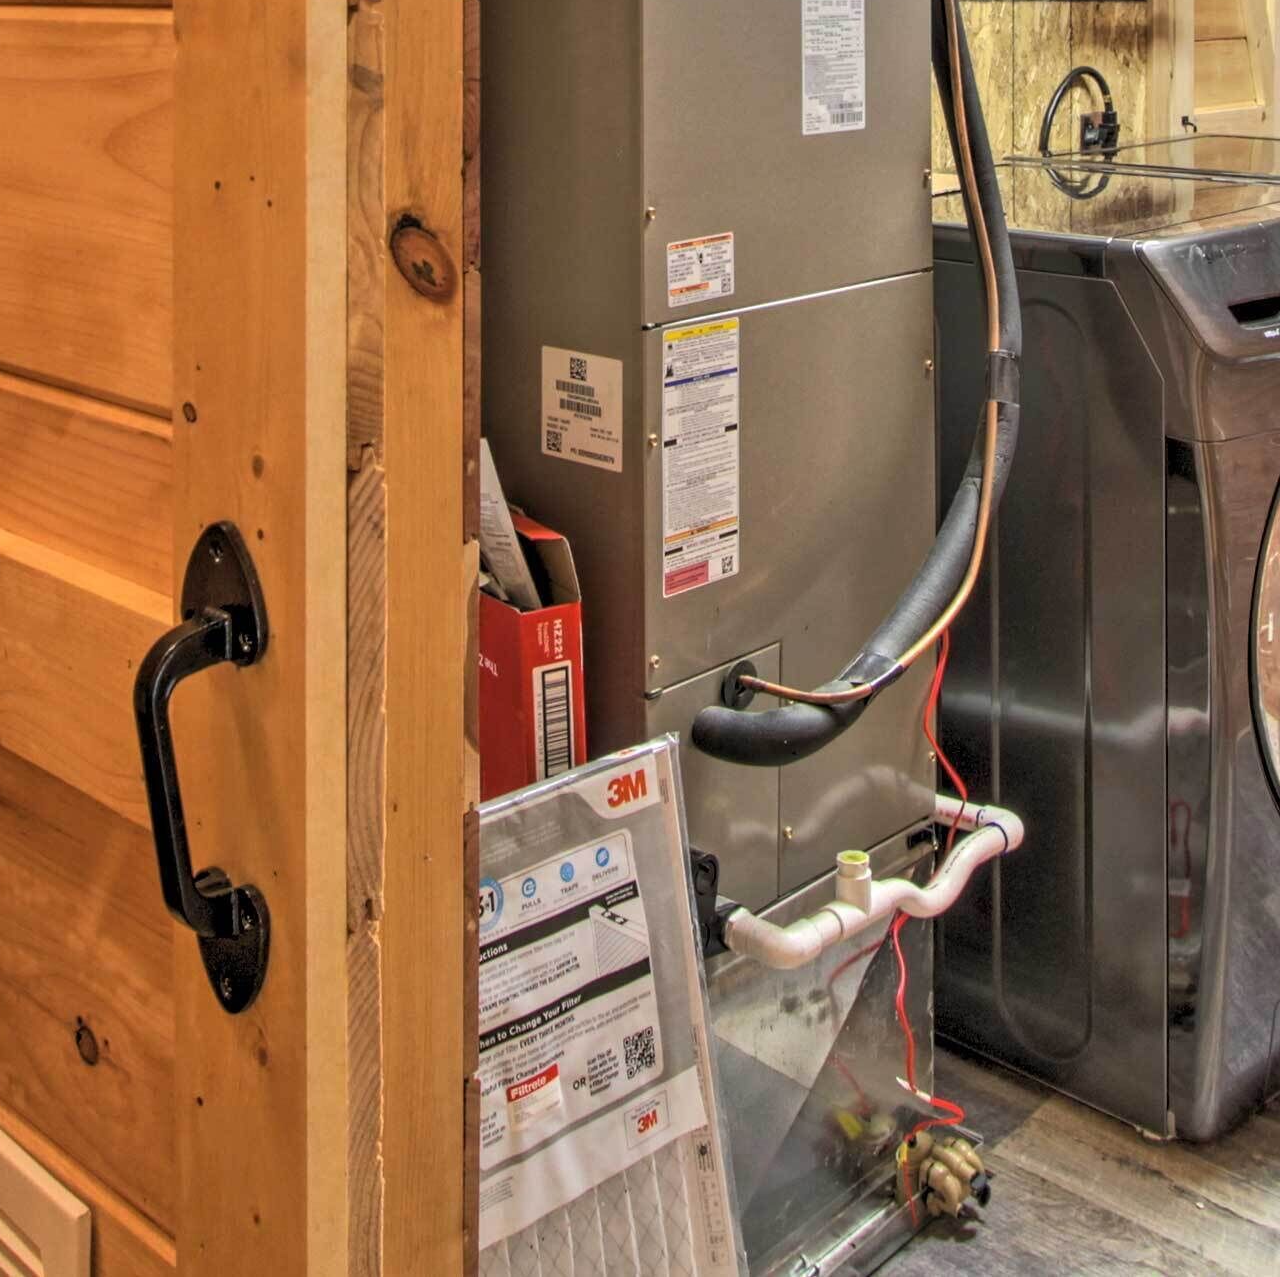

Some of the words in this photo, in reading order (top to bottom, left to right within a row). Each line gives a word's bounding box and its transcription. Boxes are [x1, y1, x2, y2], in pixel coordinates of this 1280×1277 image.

[553, 618, 564, 660] HZ221
[606, 768, 648, 809] 3M
[478, 943, 508, 962] uctions
[479, 1035, 496, 1050] hen
[497, 1030, 507, 1041] to
[509, 1017, 542, 1036] Change
[542, 1005, 561, 1021] Your
[561, 994, 582, 1012] Filter
[519, 1034, 538, 1049] EVERY
[515, 1066, 538, 1081] Change
[572, 1076, 587, 1091] OR
[637, 1108, 658, 1134] 3M
